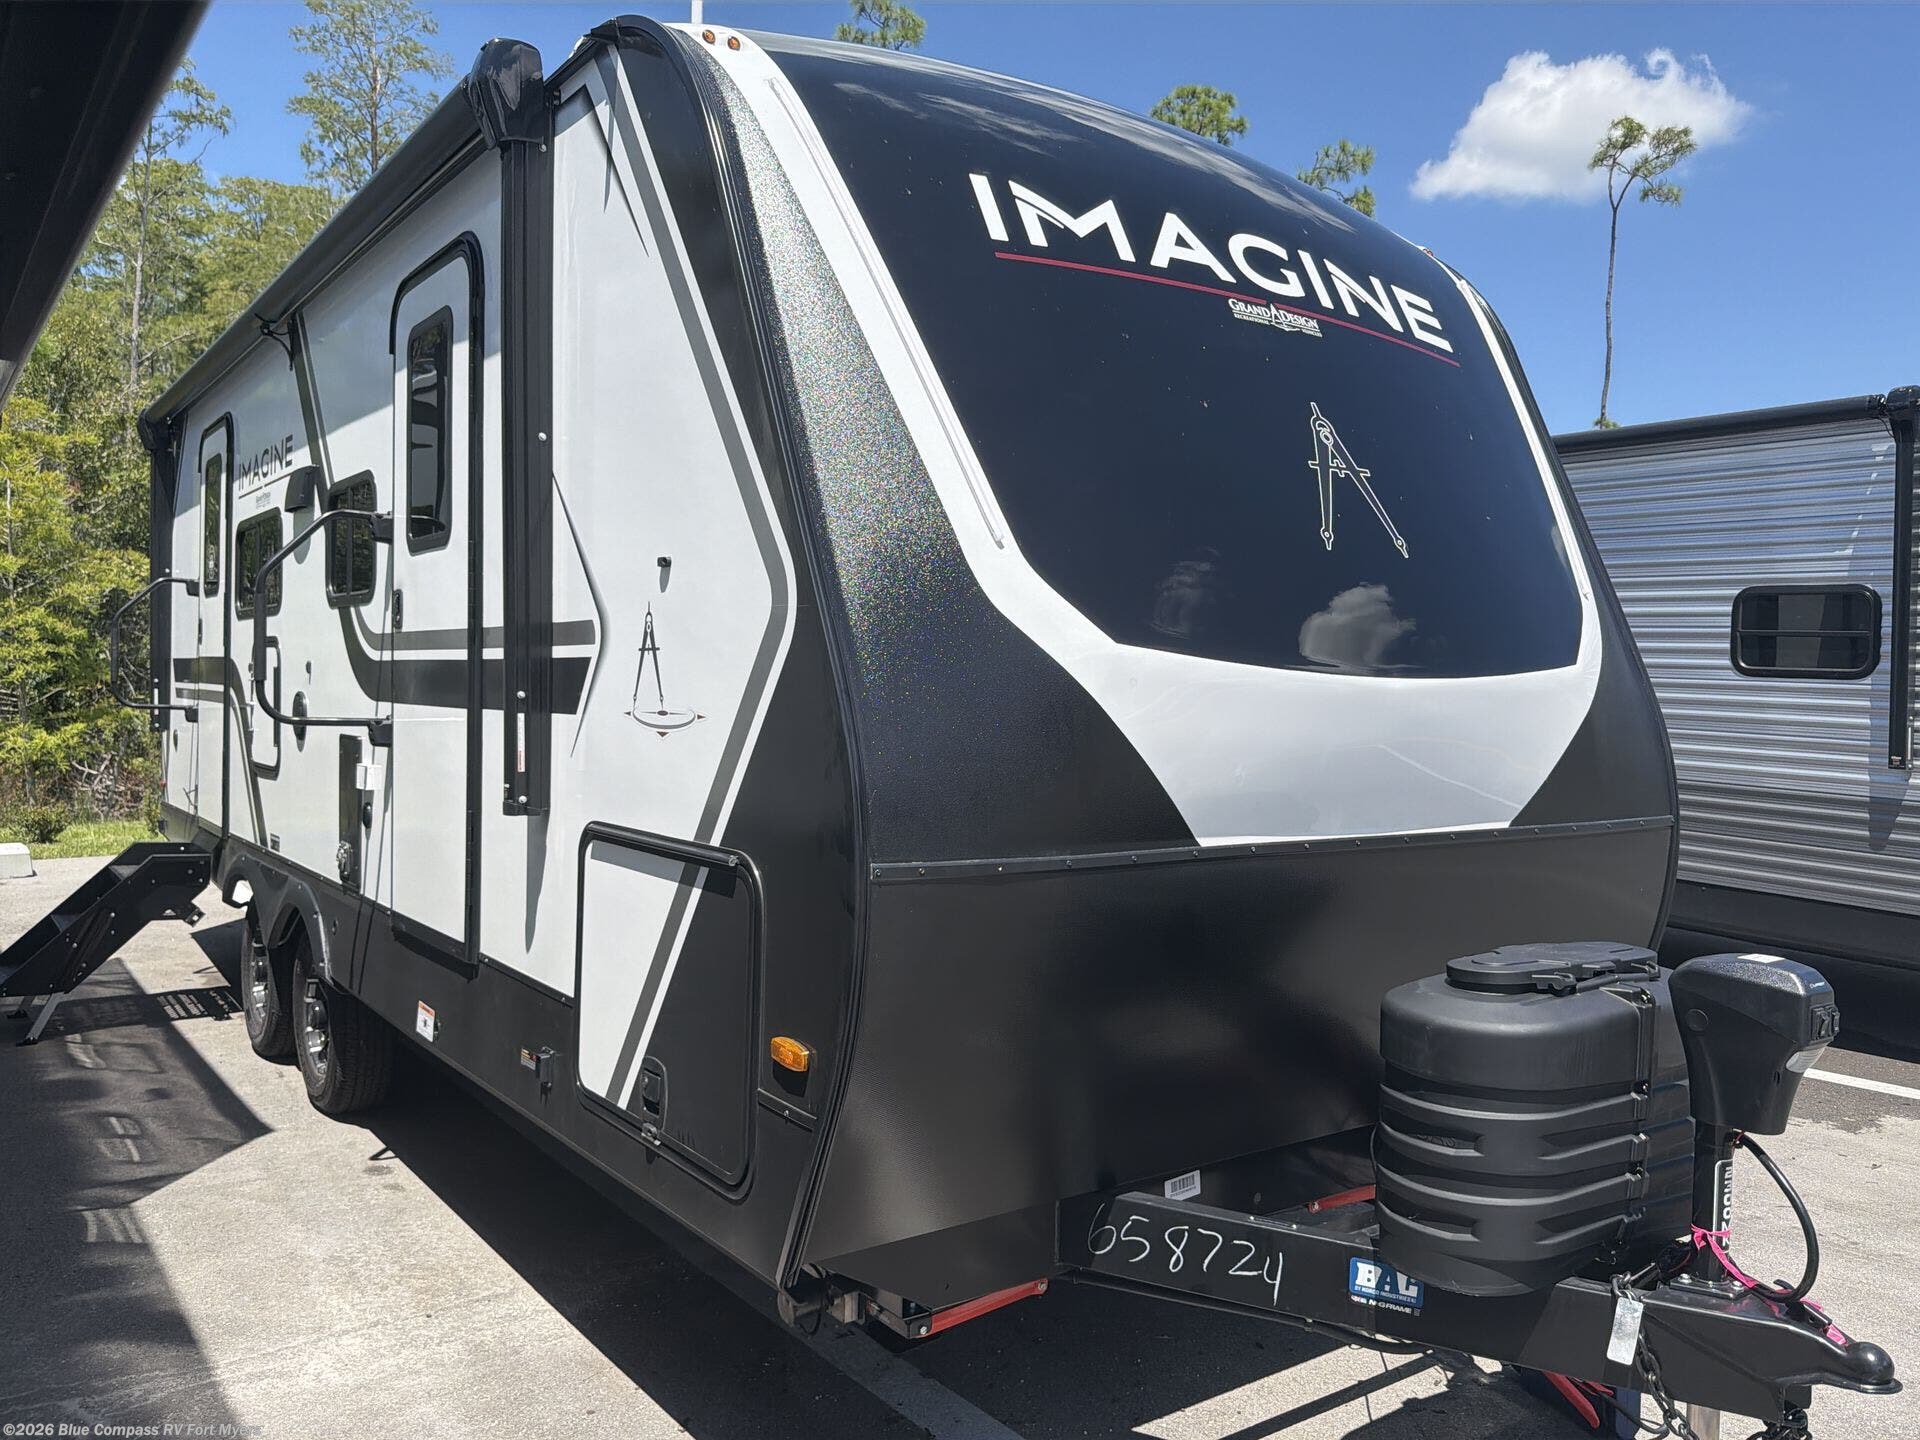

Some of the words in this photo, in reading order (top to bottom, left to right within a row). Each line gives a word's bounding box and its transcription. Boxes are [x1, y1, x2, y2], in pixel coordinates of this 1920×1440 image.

[968, 172, 1453, 353] IMAGINE
[1228, 298, 1271, 318] GRAND
[1278, 309, 1319, 329] DESIGN
[238, 434, 294, 491] IMAGINE
[1087, 1202, 1284, 1306] 658724
[1355, 1262, 1418, 1298] BAL
